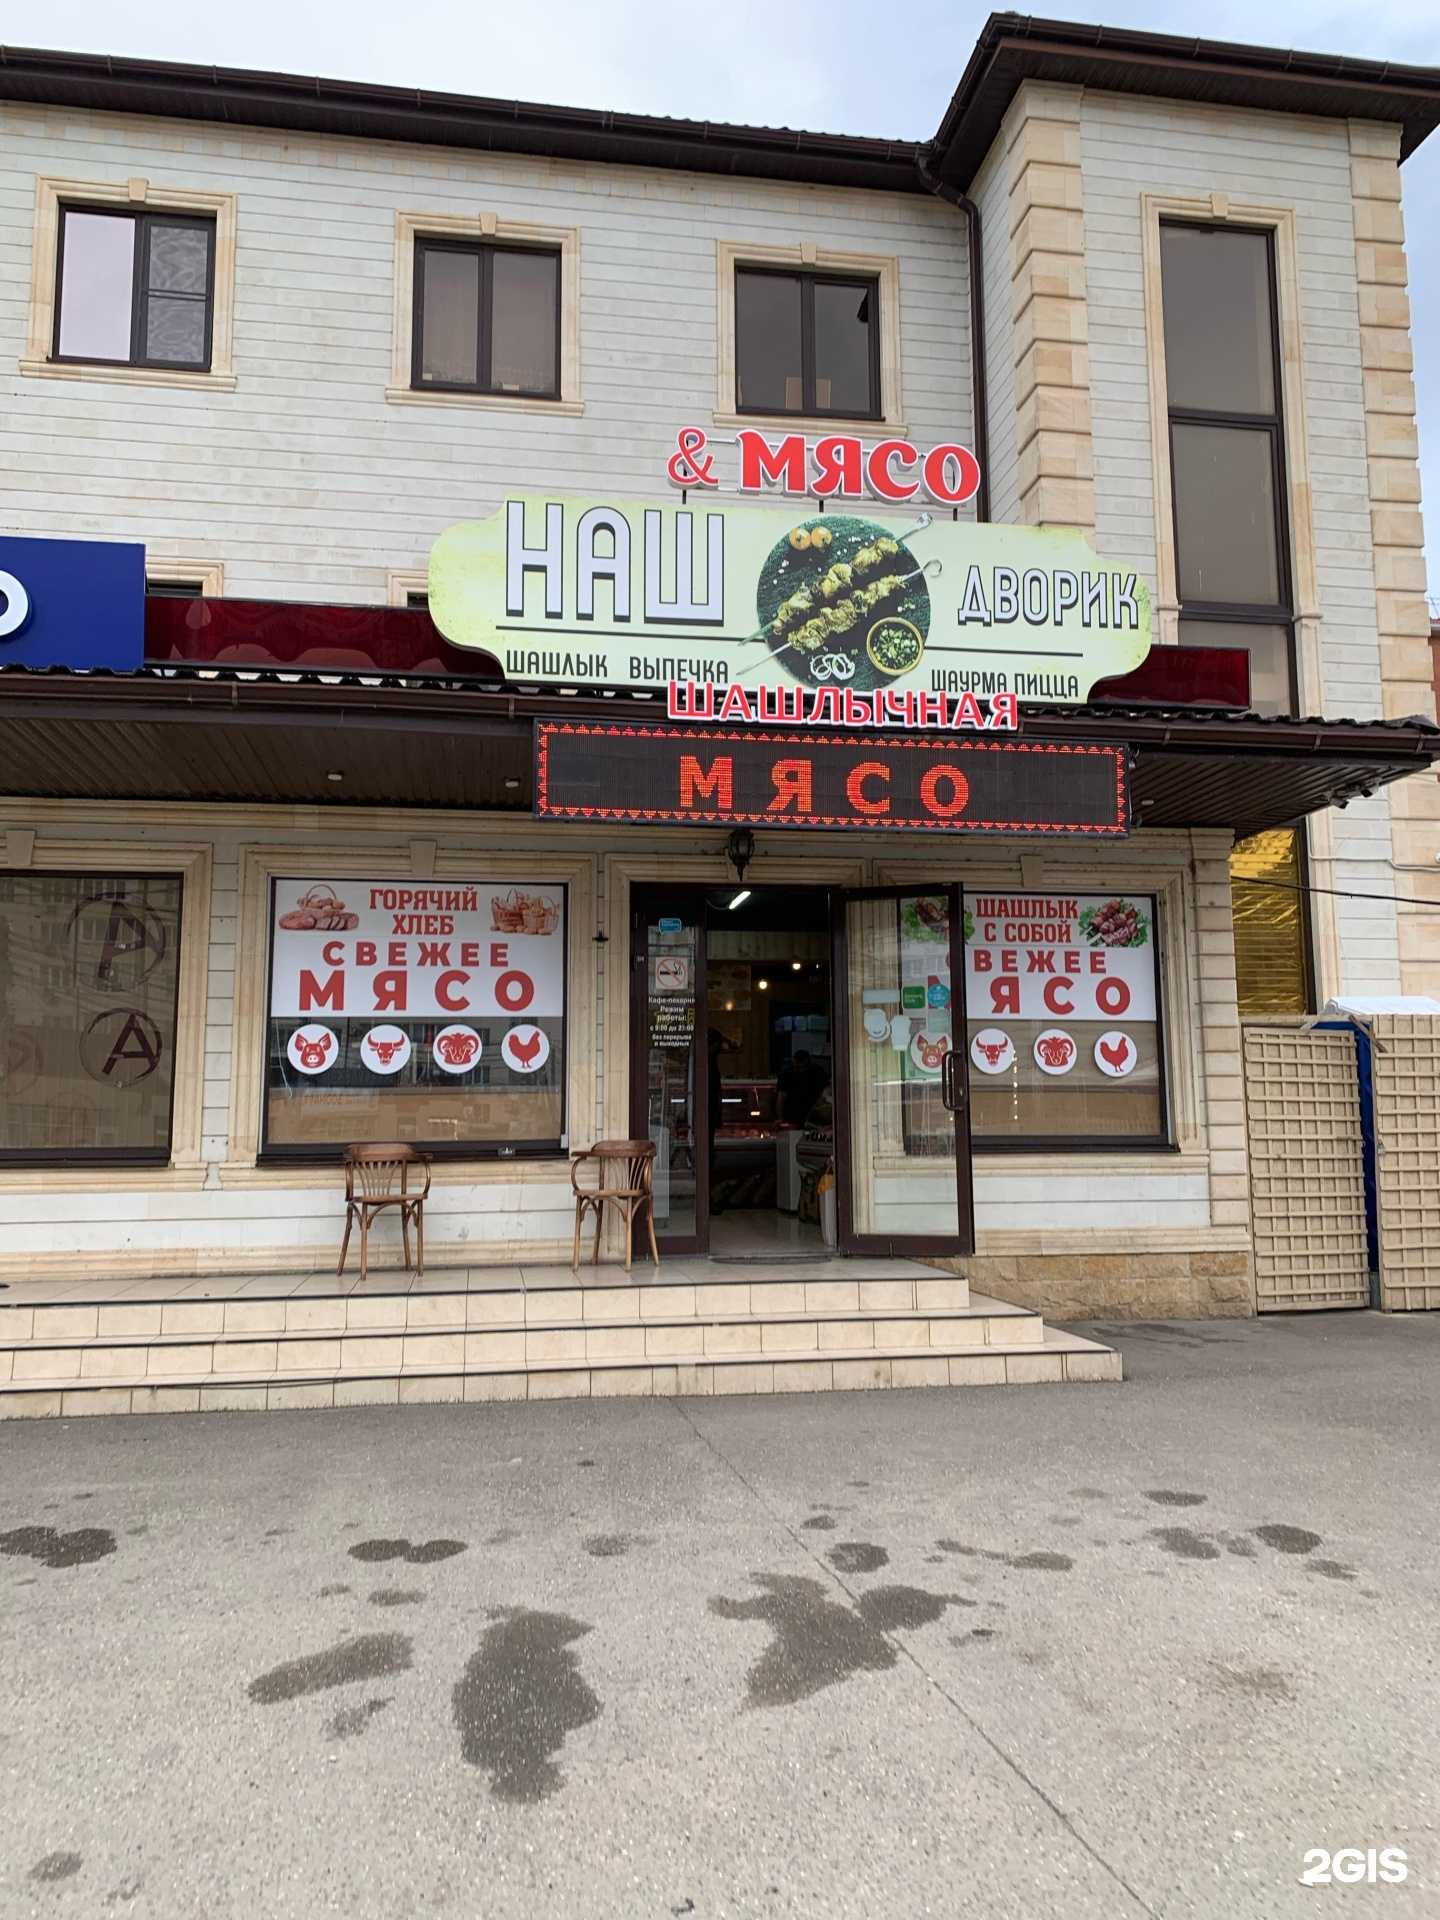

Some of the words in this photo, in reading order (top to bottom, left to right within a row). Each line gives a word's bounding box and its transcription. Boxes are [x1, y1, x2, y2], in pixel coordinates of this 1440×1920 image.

[667, 427, 720, 485] &
[737, 429, 981, 504] МЯСО
[505, 500, 725, 627] НАШ
[957, 564, 1140, 630] ДВОРИК
[506, 650, 608, 678] ШАШЛЫК
[629, 656, 729, 684] ВЫПЕЧКА
[931, 669, 1008, 694] ШАУРМА
[1014, 673, 1079, 699] ПИЦЦА
[667, 680, 1018, 730] ШАШЛЫЧНАЯ
[678, 755, 970, 817] МЯСО
[369, 886, 478, 913] ГОРЯЧИЙ
[976, 898, 1079, 920] ШАШЛЫК
[391, 913, 455, 936] ХЛЕБ
[983, 922, 997, 943] С
[1003, 918, 1072, 944] СОБОЙ
[322, 941, 509, 967] СВЕЖЕЕ
[945, 949, 1107, 974] ВЕЖЕЕ
[298, 969, 535, 1013] МЯСО
[928, 975, 1131, 1016] ЯСО
